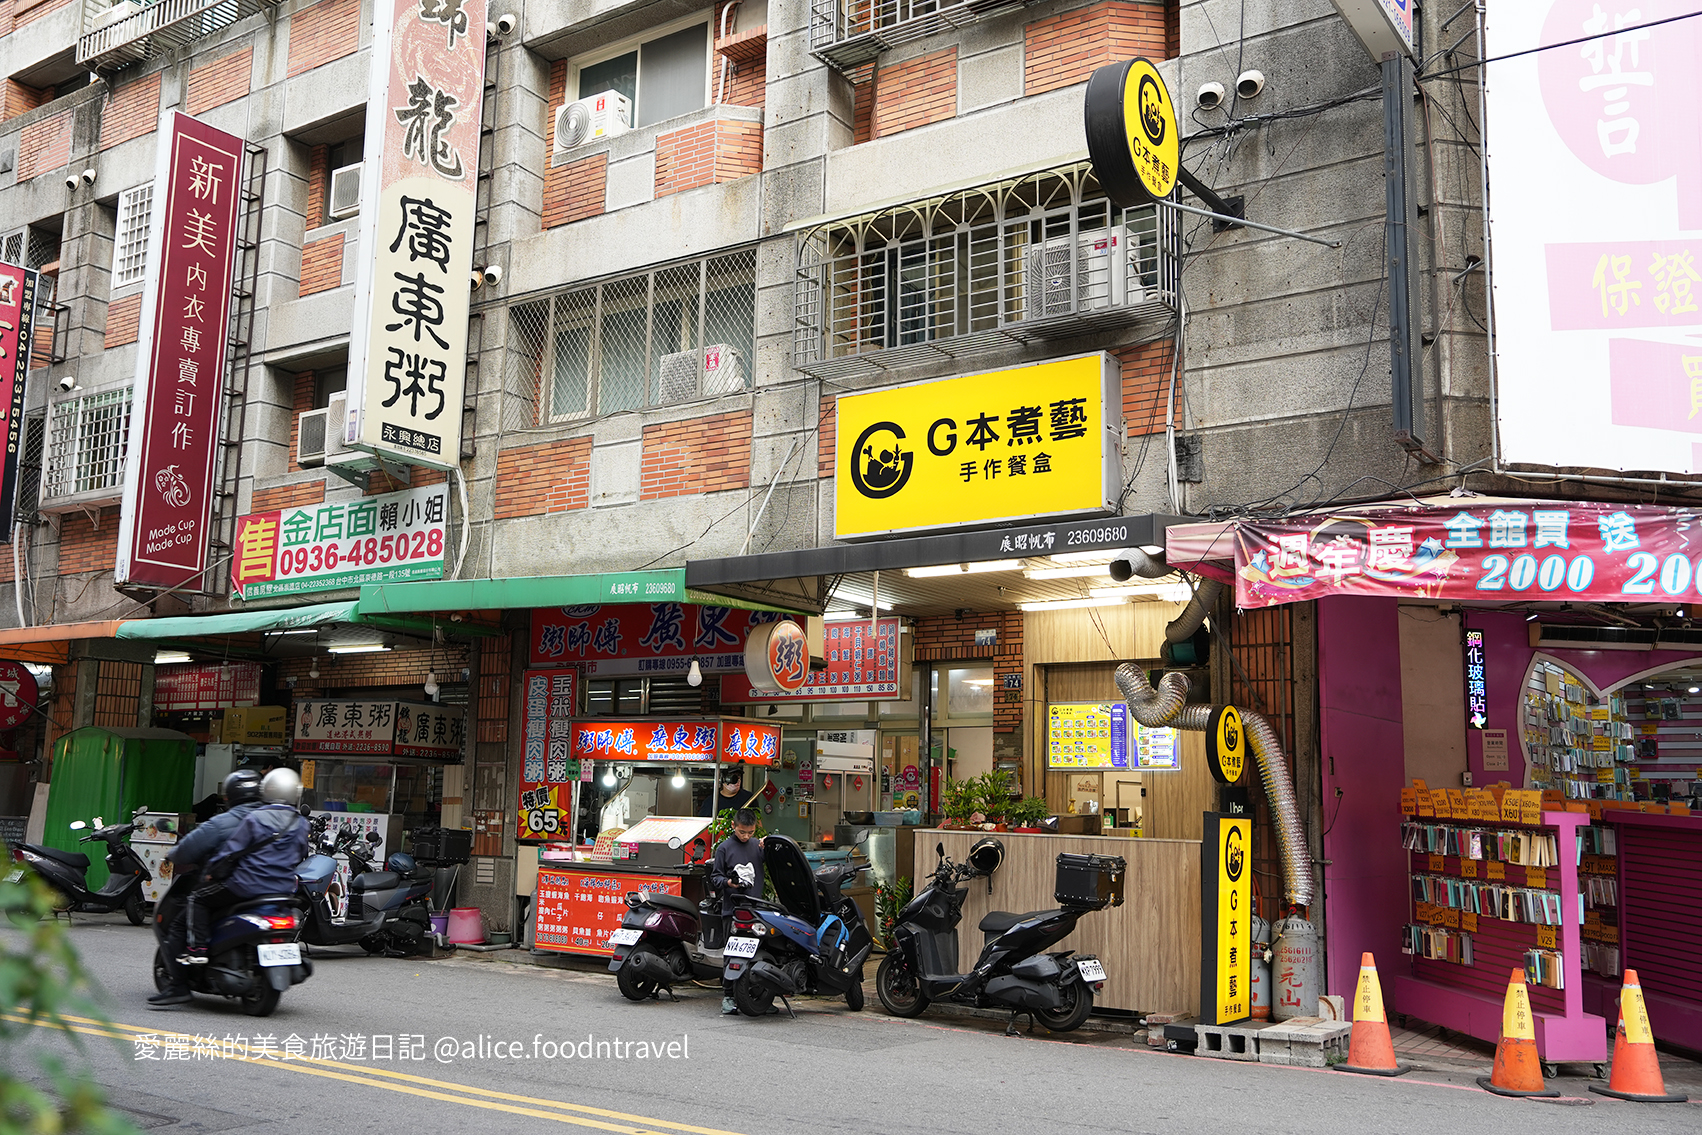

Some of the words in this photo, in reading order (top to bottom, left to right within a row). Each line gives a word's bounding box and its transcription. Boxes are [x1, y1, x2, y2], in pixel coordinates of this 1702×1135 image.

[1579, 3, 1654, 158] 誓
[382, 195, 454, 420] 廣東粥
[383, 425, 440, 452] 永興總店
[927, 397, 1088, 456] G本煮藝
[960, 452, 1052, 482] 手作餐盒
[148, 522, 177, 542] Made
[177, 518, 196, 537] Cup
[282, 502, 377, 547] 金店面
[379, 494, 444, 532] 賴小姐
[1000, 531, 1056, 553] 展昭帆布
[1067, 525, 1127, 545] 23609680
[1443, 510, 1570, 549] 全館買
[1598, 511, 1641, 554] 送
[146, 537, 174, 556] Made
[174, 532, 194, 549] Cup
[238, 517, 277, 581] 售
[280, 528, 444, 576] 0936-485028
[1267, 525, 1416, 587] 週年慶
[645, 582, 676, 595] 23609680
[1477, 553, 1595, 592] 2000
[1622, 552, 1702, 595] 20
[539, 619, 622, 657] 粥師傅
[775, 635, 805, 682] 粥
[1466, 631, 1486, 713] 鋼化玻璃貼
[316, 702, 391, 728] 廣東粥
[524, 675, 549, 783] 皮蛋瘦肉粥
[547, 675, 572, 783] 玉米瘦肉粥
[576, 728, 637, 754] 粥師傅
[646, 724, 717, 752] 廣東粥
[724, 727, 778, 759] 廣東粥
[522, 786, 551, 811] 特價
[1504, 809, 1518, 819] X60
[528, 809, 568, 836] 65元
[1585, 861, 1595, 872] 9T
[1540, 936, 1552, 945] V29
[1279, 967, 1303, 1007] 元山
[1362, 975, 1371, 1013] 禁止停車
[1516, 989, 1526, 1030] 禁止停車
